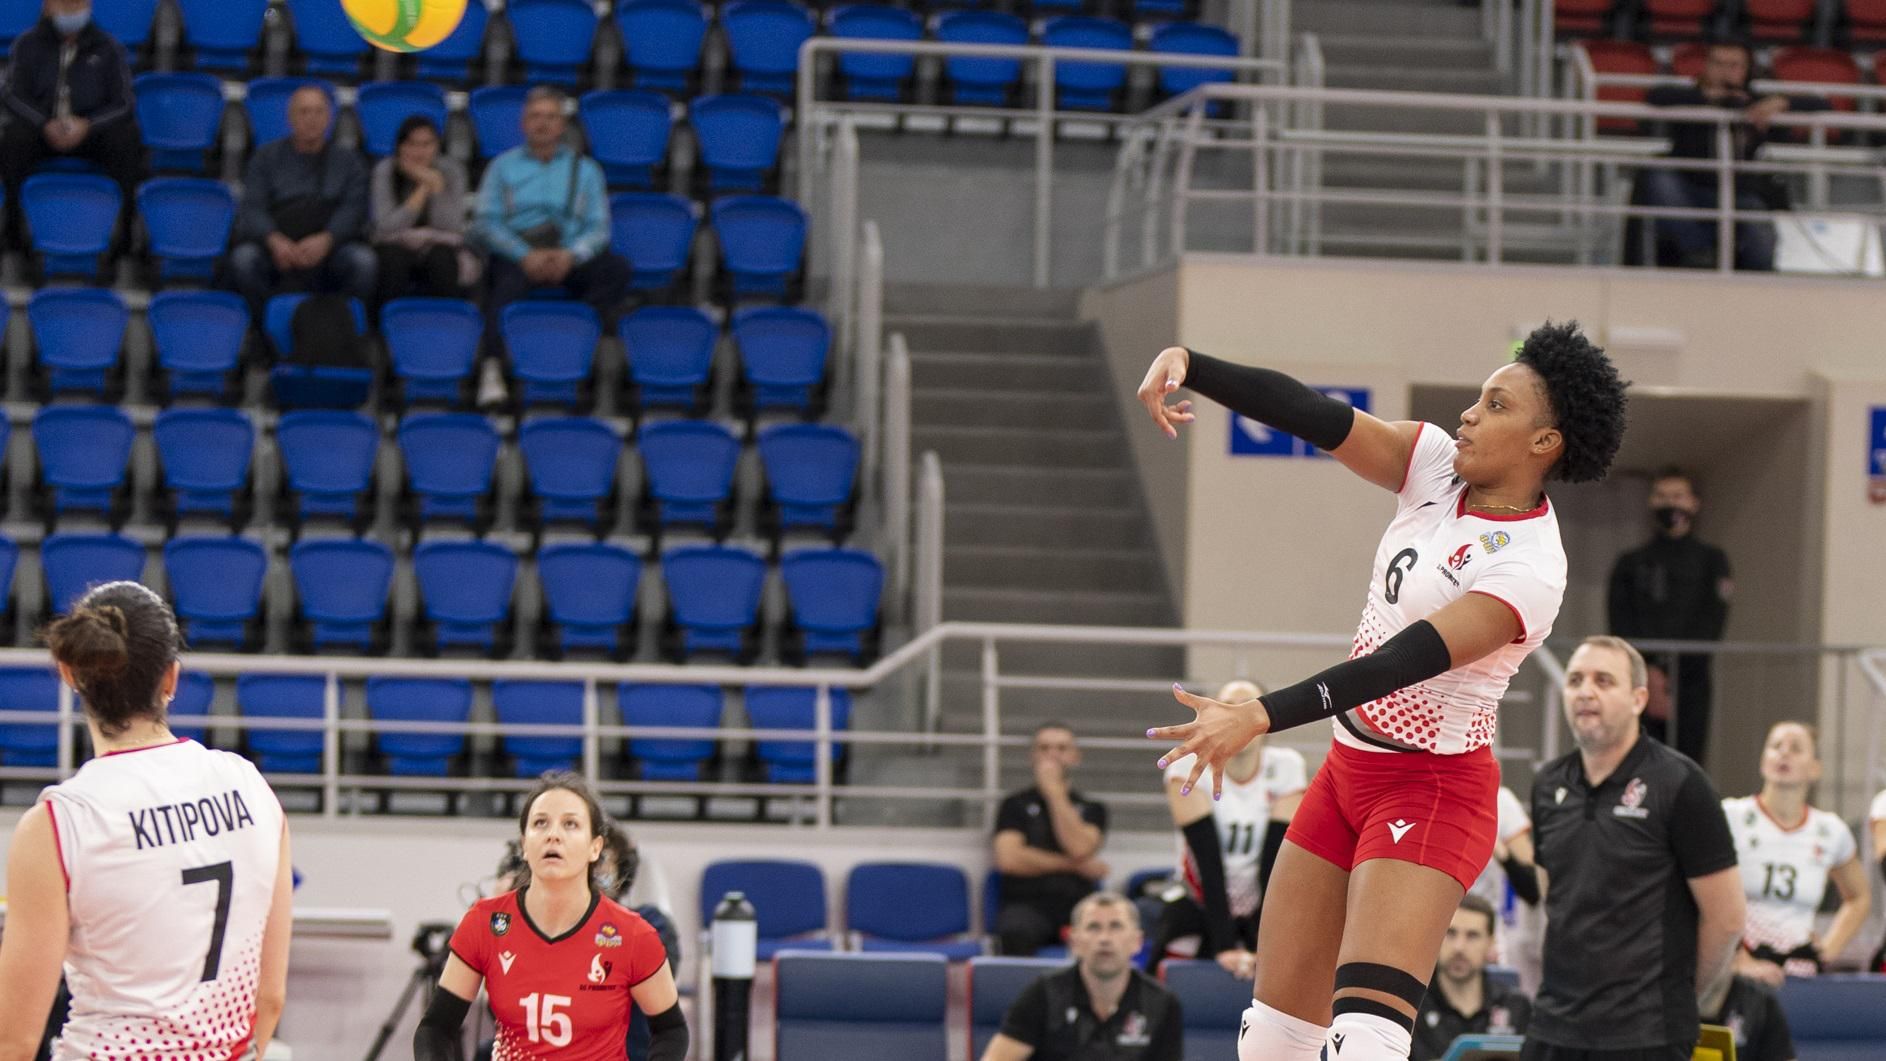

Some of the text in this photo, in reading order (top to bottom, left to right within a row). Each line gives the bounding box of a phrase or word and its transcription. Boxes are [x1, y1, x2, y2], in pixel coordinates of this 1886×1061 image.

[1385, 548, 1418, 604] 6
[128, 790, 255, 850] KITIPOVA
[1228, 824, 1254, 853] 11
[1762, 863, 1797, 900] 13
[181, 860, 234, 983] 7
[519, 992, 573, 1048] 15
